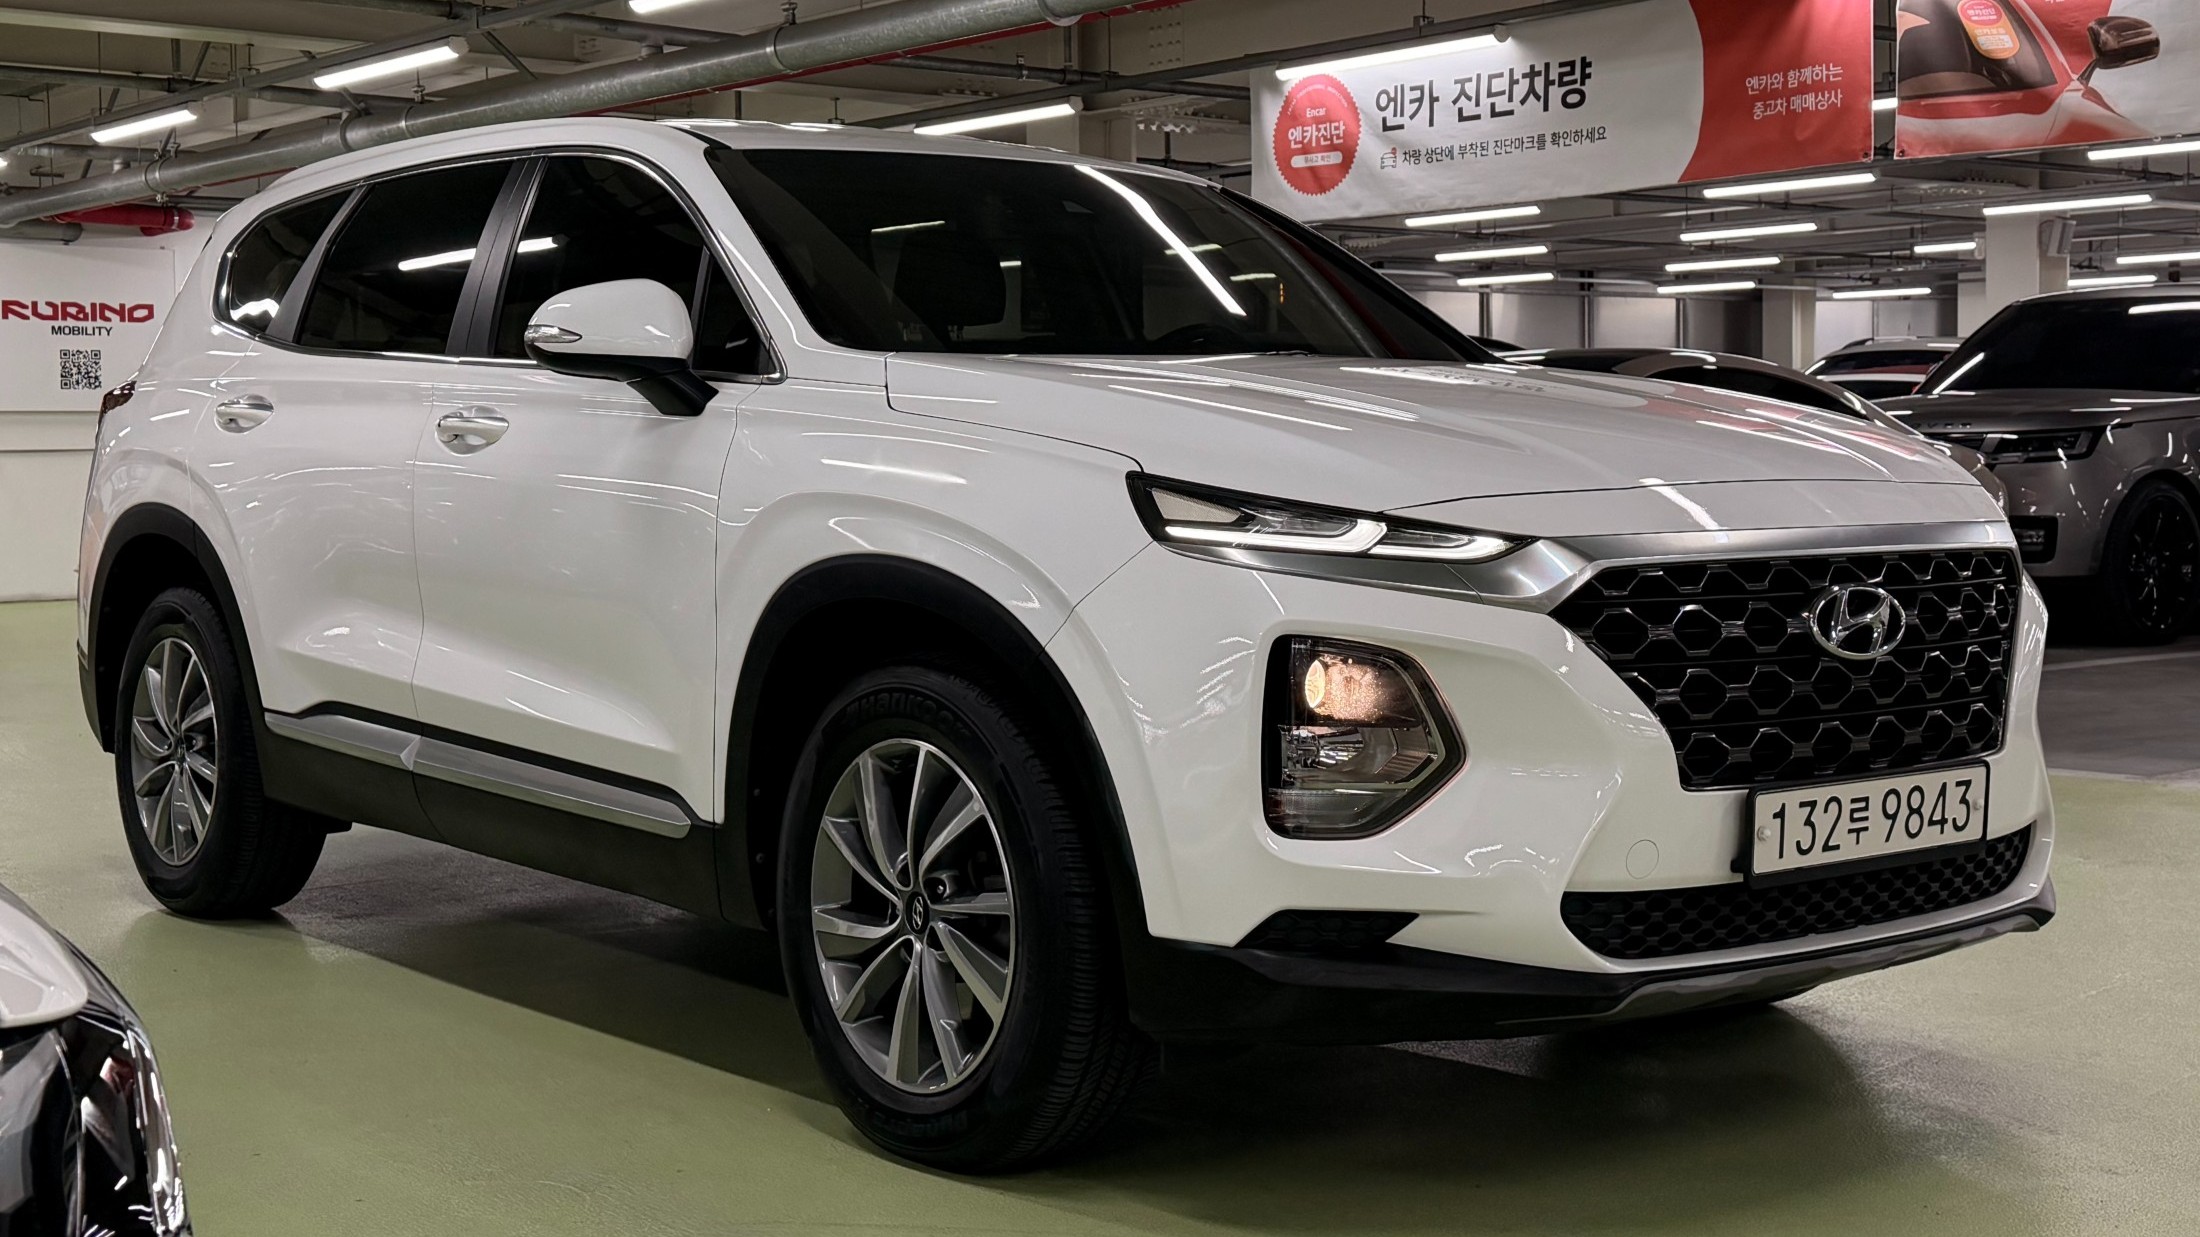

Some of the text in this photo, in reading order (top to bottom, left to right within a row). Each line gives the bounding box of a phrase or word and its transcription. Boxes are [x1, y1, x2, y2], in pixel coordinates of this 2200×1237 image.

[1375, 56, 1592, 133] 엔카 진단차량
[1745, 62, 1843, 95] 엔카와 함께하는
[1306, 107, 1327, 118] Encar
[1753, 88, 1843, 120] 중고차 매매상사
[1288, 120, 1345, 149] 엔카진단
[1402, 126, 1607, 165] 차량 상단에 부착된 진단마크를 확인하세요
[1, 300, 155, 323] RUBINO
[51, 325, 113, 336] MOBILITY
[1772, 778, 1973, 859] 132루 9843
